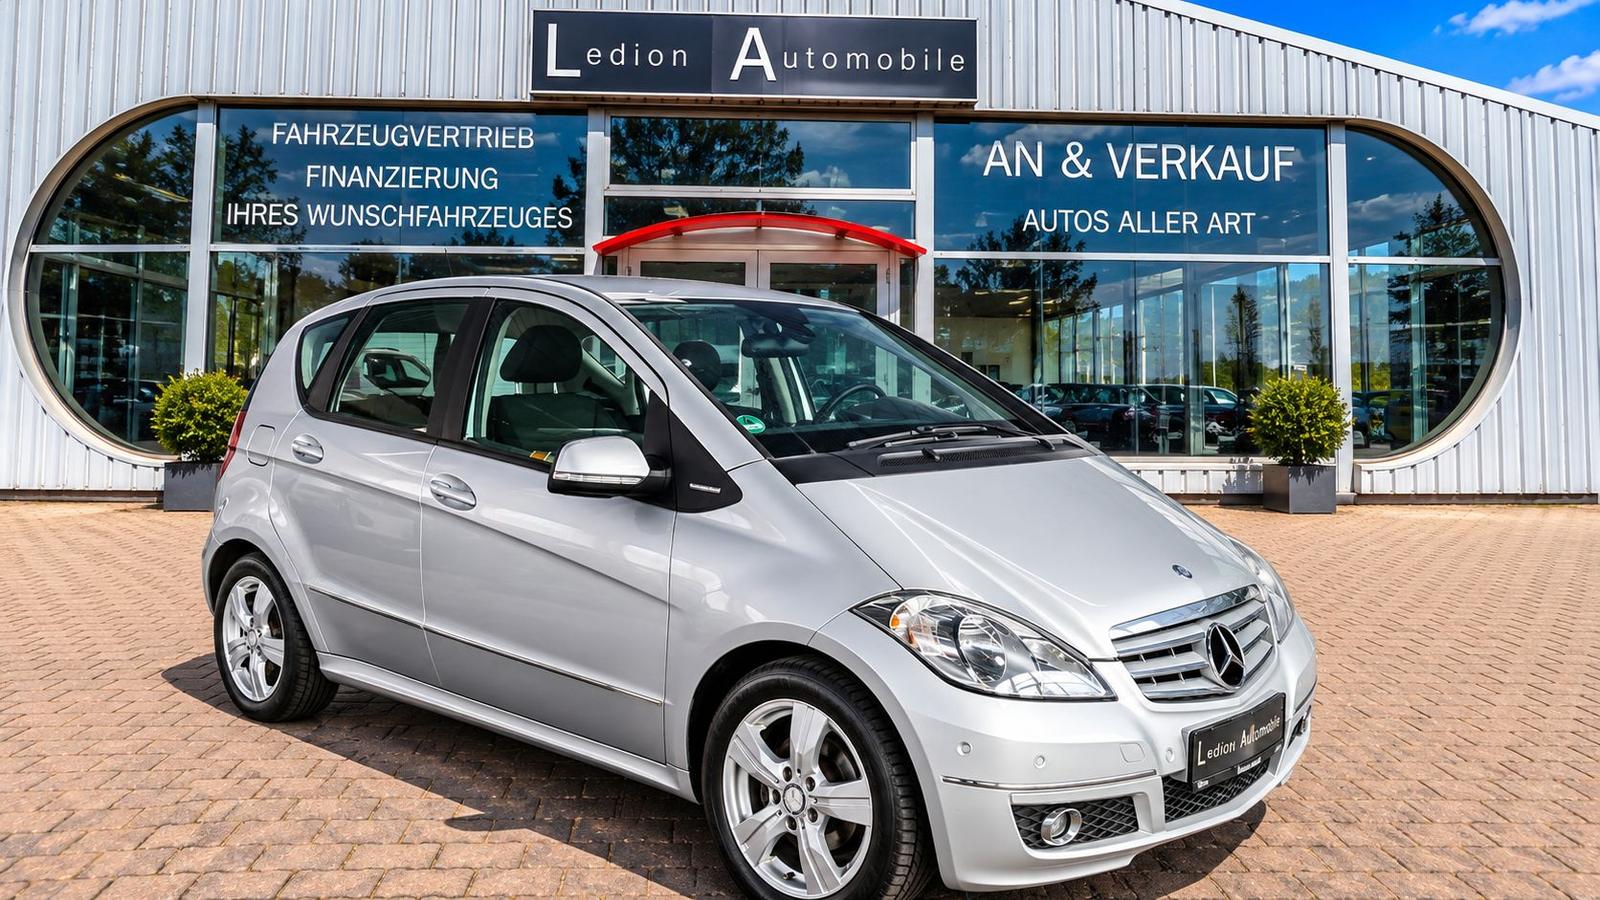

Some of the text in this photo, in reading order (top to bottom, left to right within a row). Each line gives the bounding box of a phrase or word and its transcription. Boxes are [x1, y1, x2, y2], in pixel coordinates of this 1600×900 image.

[546, 23, 966, 82] Ledion Automobile
[271, 122, 535, 150] FAHRZEUGVERTRIEB
[982, 140, 1296, 183] AN & VERKAUF
[305, 165, 499, 191] FINANZIERUNG
[226, 203, 574, 229] IHRES WUNSCHFAHRZEUGES
[1022, 208, 1257, 236] AUTOS ALLER ART
[1197, 740, 1236, 767] Ledion
